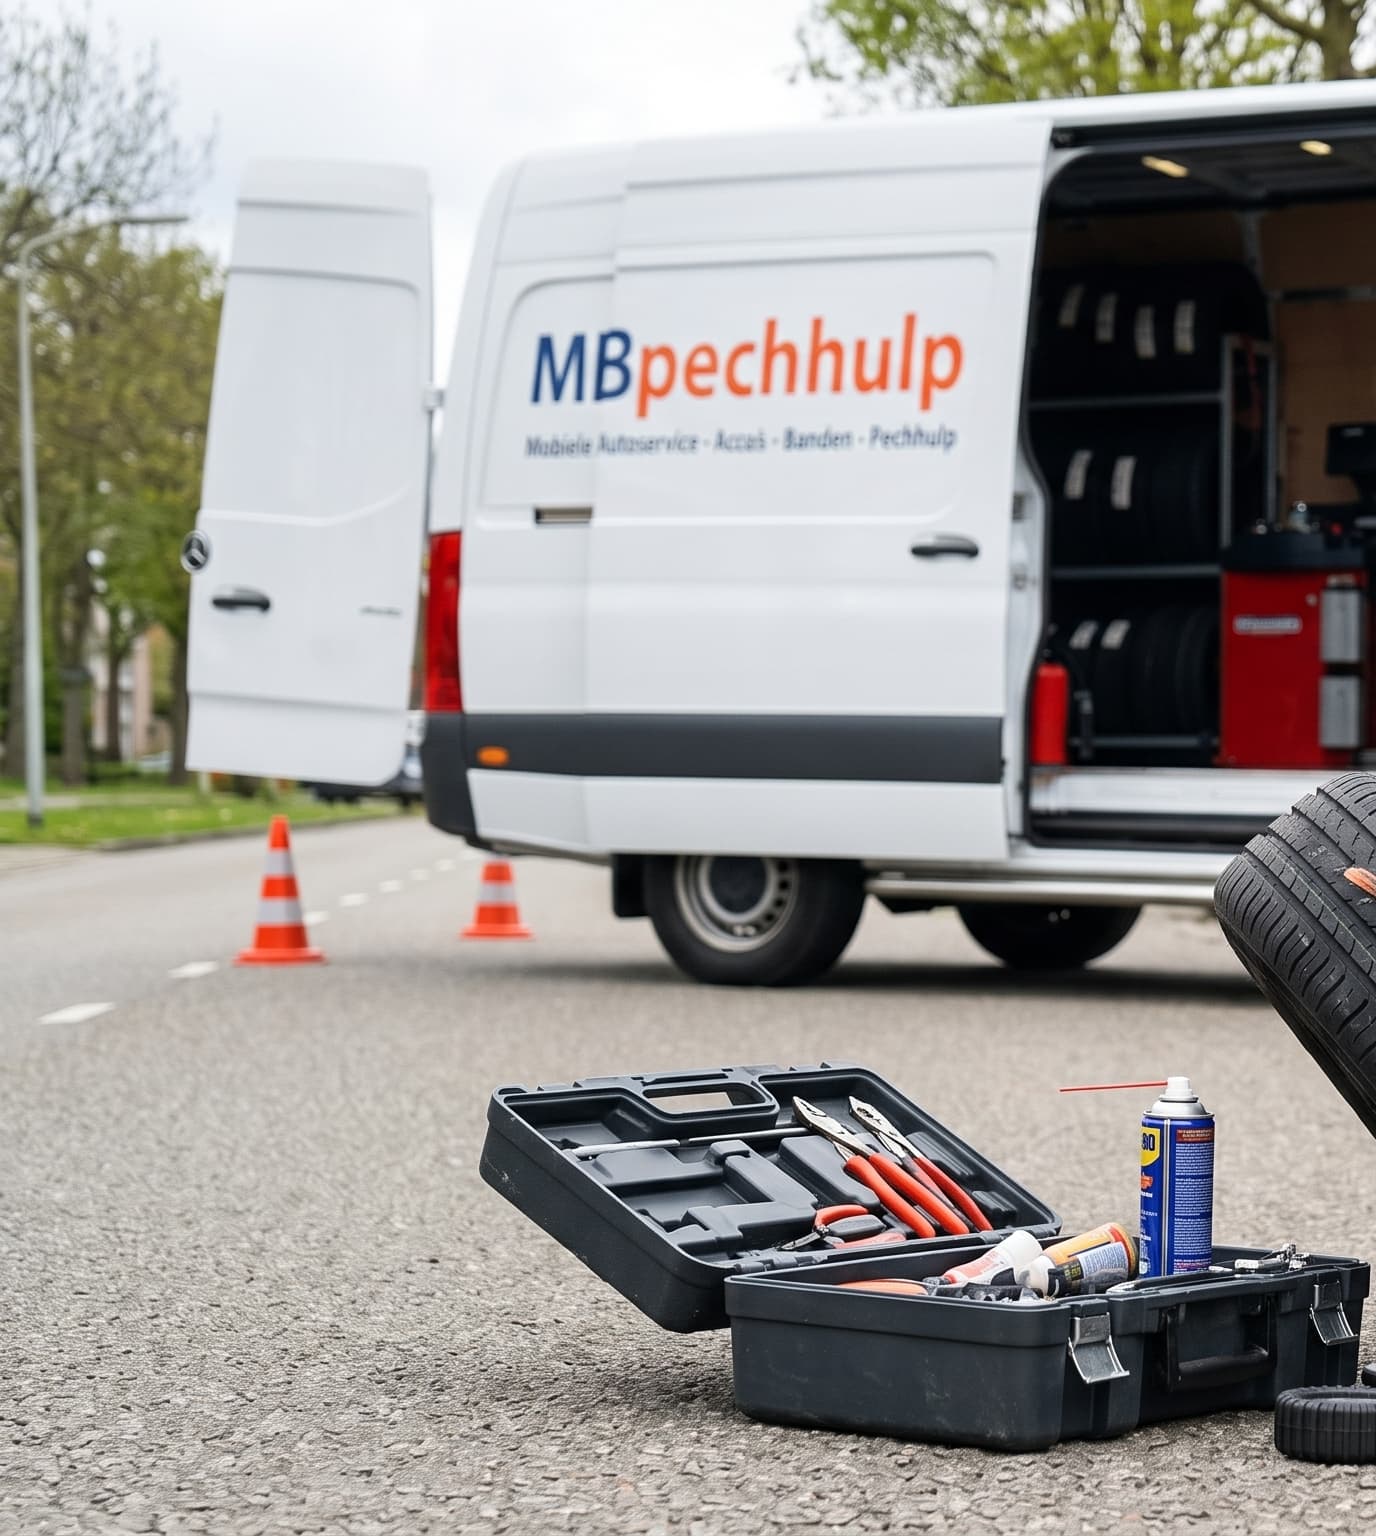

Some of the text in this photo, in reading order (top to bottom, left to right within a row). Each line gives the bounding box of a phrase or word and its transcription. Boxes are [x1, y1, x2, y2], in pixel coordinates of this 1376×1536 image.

[530, 312, 965, 419] MBpechhulp
[527, 434, 592, 458] Mobiele
[599, 431, 699, 454] Autoservice
[784, 426, 852, 451] Banden
[869, 423, 957, 454] Pechhulp
